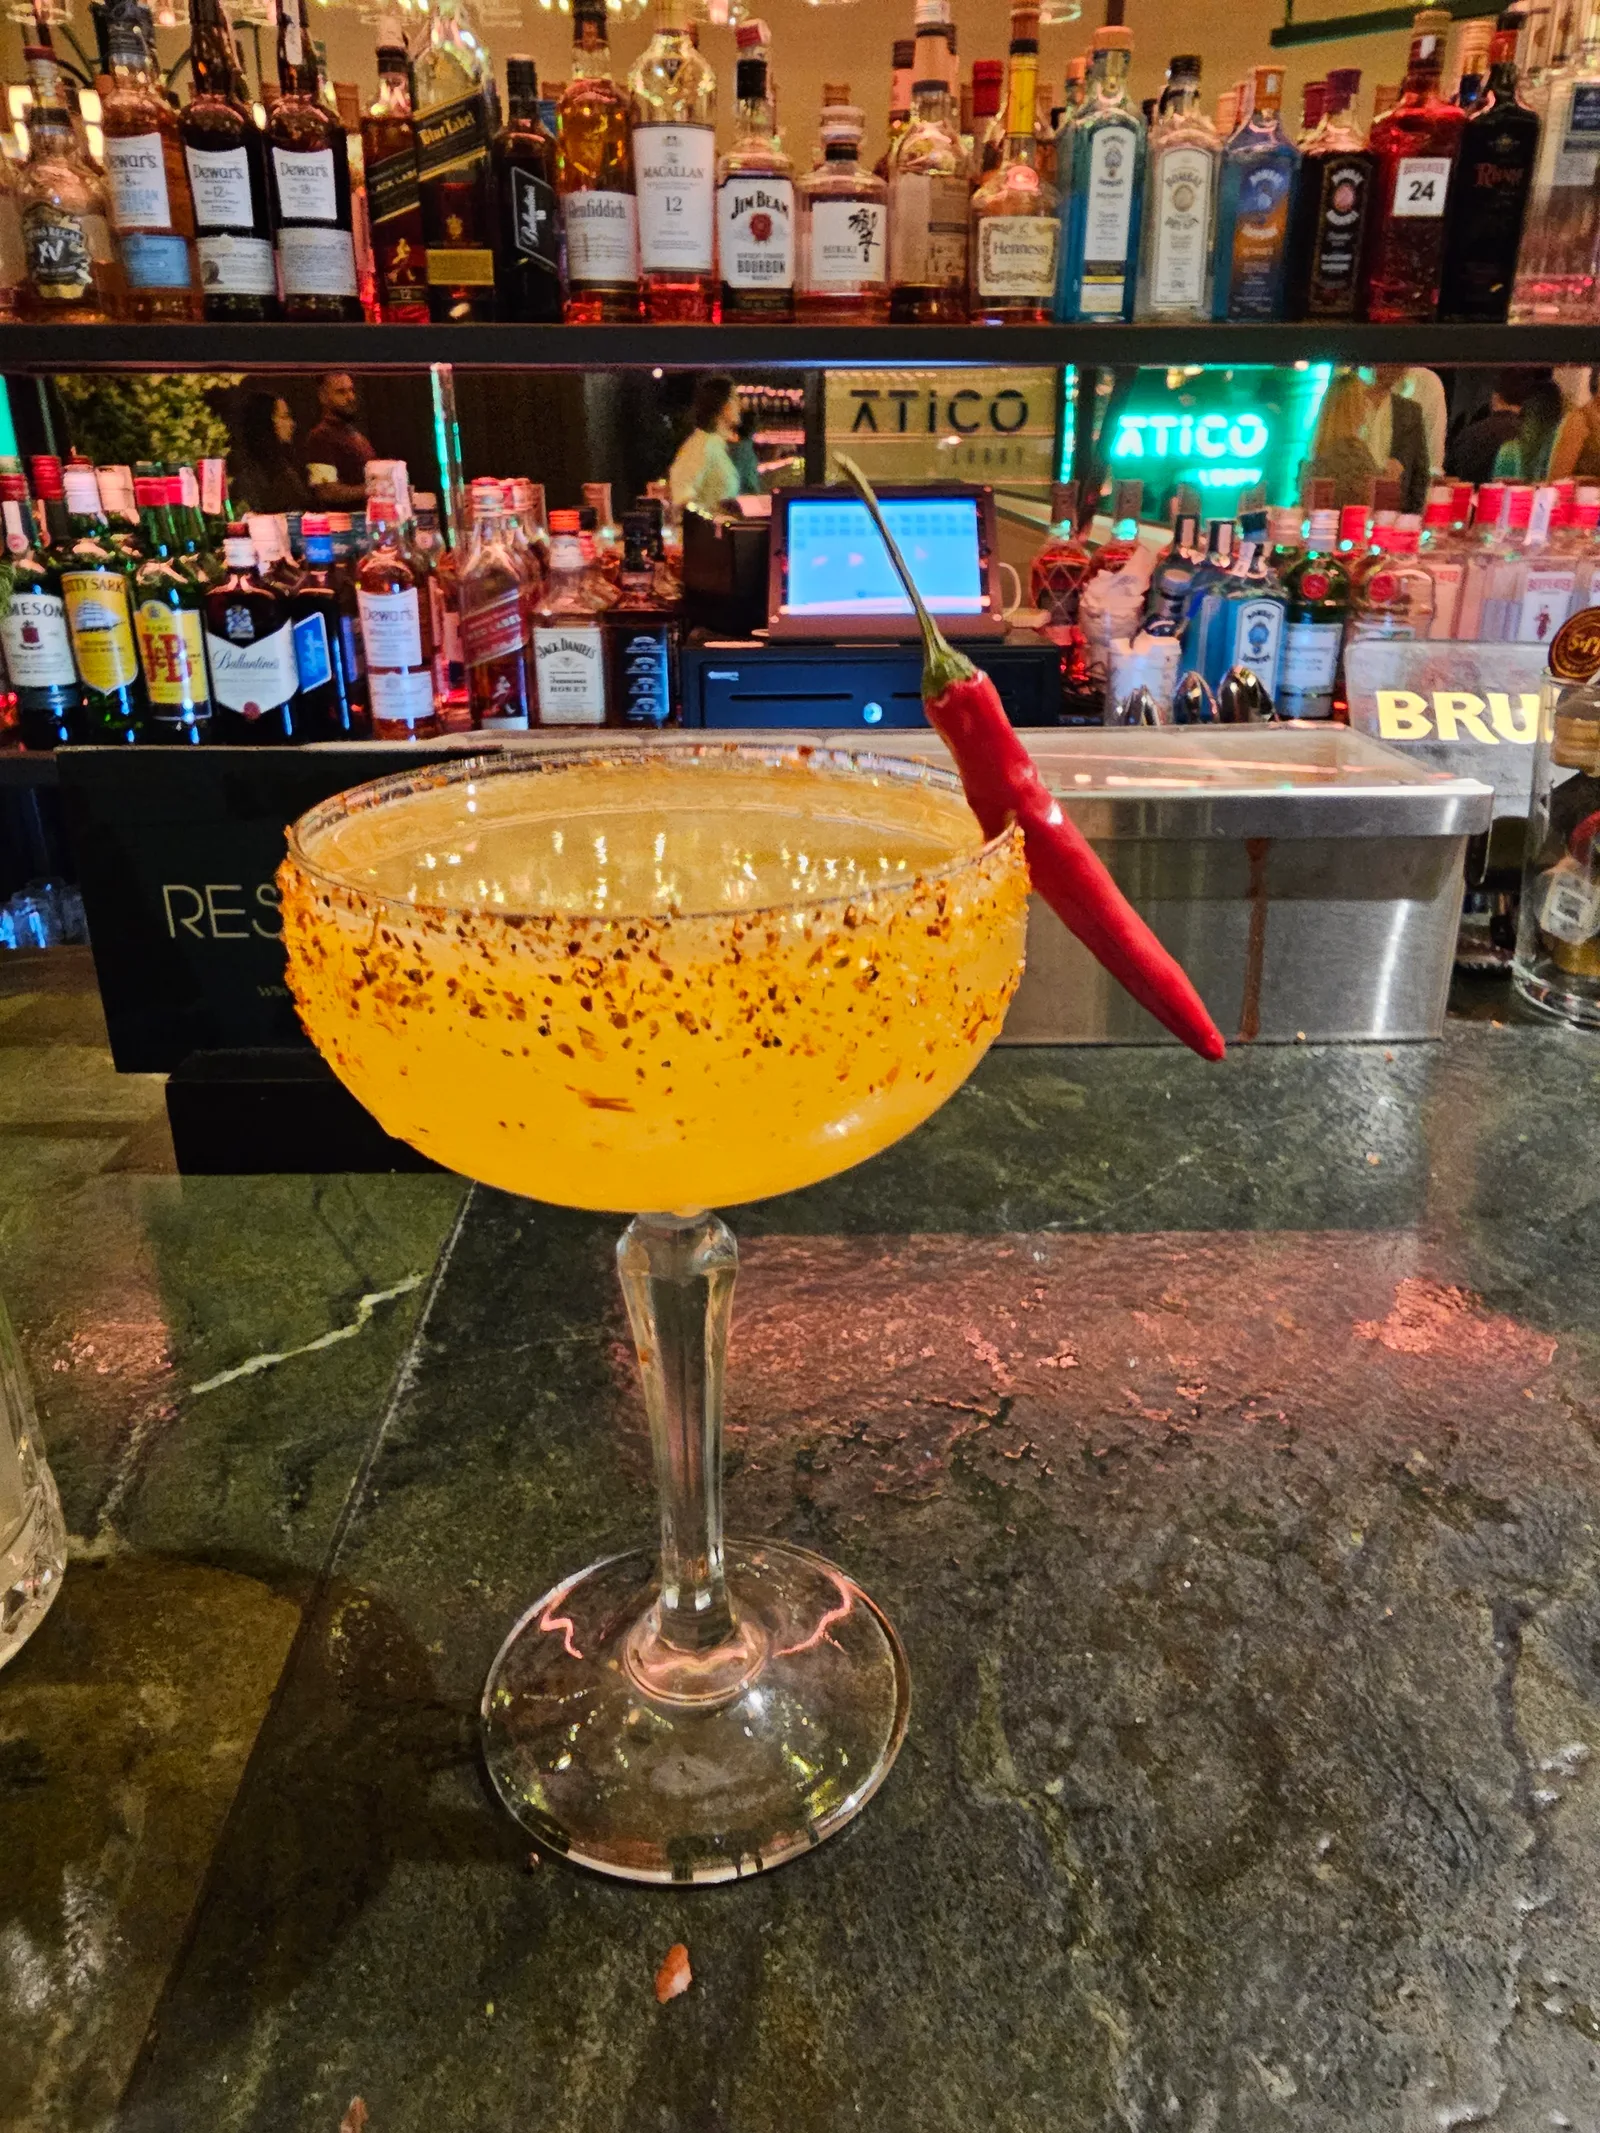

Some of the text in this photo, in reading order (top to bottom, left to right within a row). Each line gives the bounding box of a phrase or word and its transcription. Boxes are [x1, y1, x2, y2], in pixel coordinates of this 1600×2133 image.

[193, 164, 245, 180] Dewar's
[643, 166, 706, 178] MACALLAN
[1408, 180, 1436, 202] 24
[665, 196, 684, 213] 12
[731, 190, 790, 221] JIM BEAM
[737, 260, 786, 274] BOURBON
[363, 606, 415, 622] Dewar's
[539, 637, 597, 660] JACK DANIEL'S
